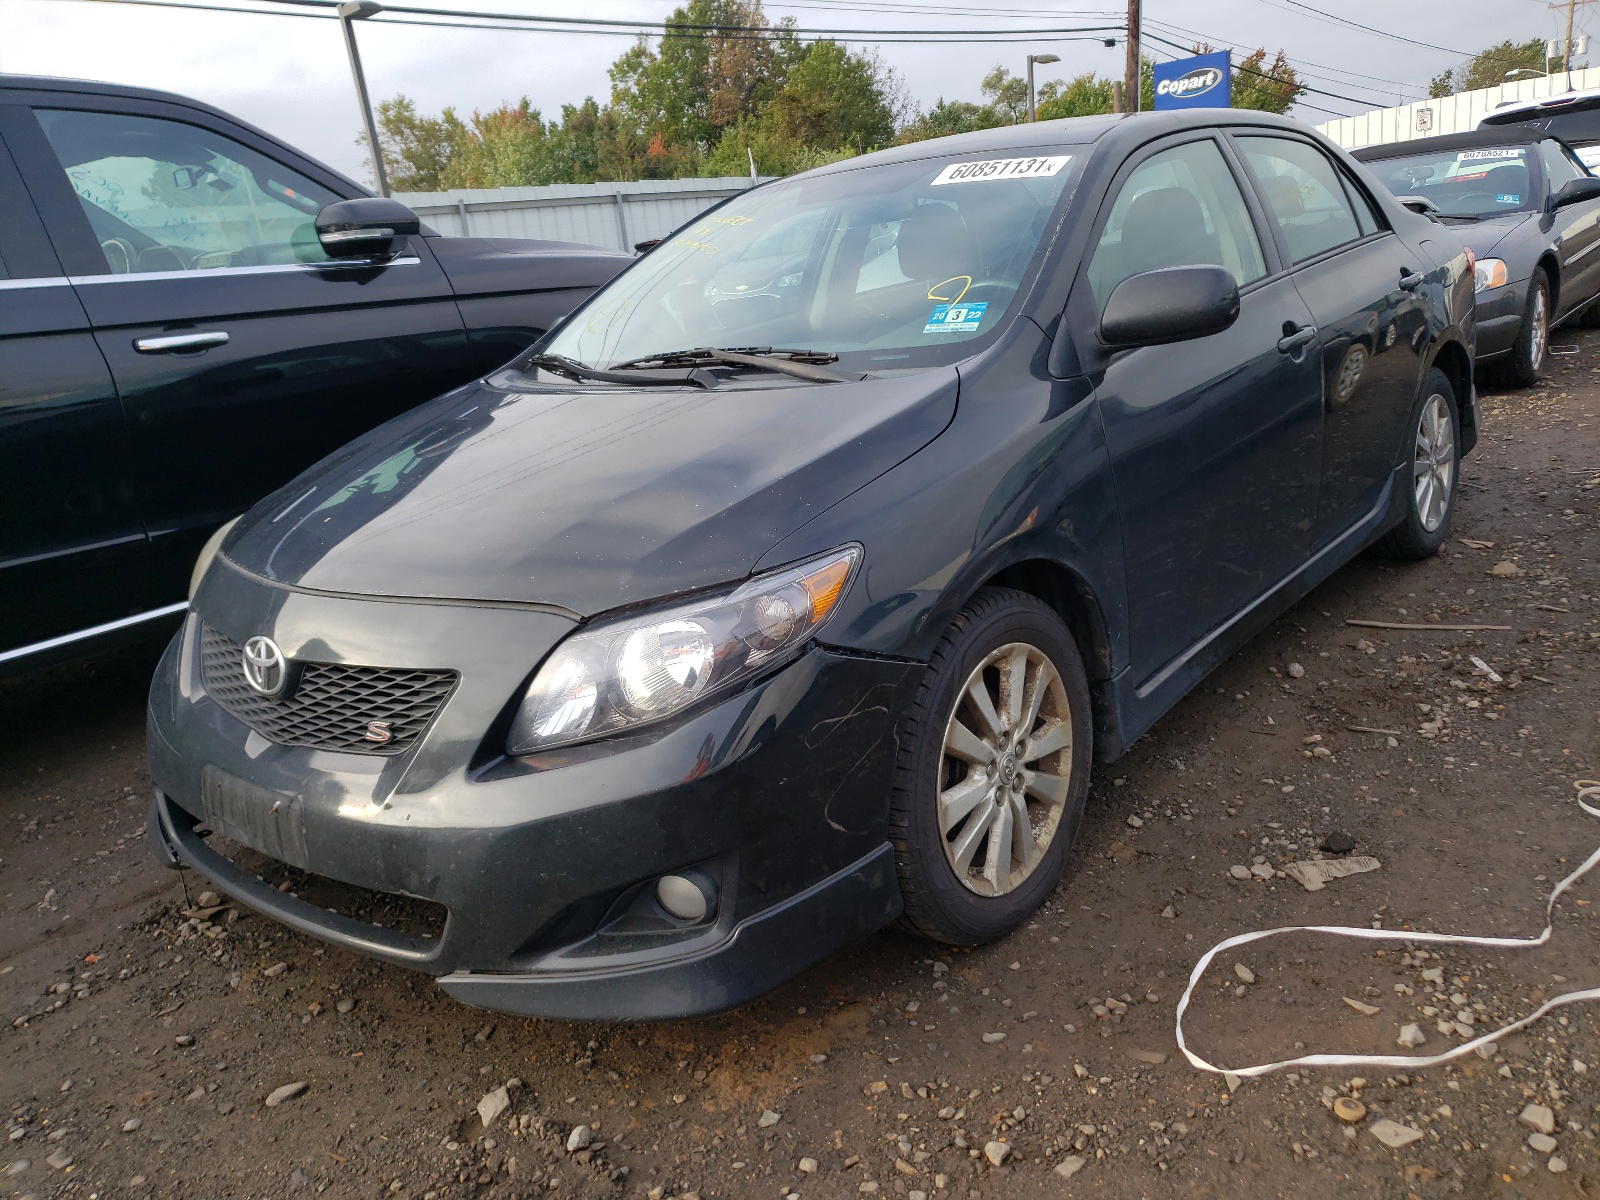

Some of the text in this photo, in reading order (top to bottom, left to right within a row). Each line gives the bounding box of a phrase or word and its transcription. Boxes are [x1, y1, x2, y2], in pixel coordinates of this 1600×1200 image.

[1157, 69, 1216, 95] Copart
[951, 310, 962, 321] 3
[366, 720, 391, 742] S
